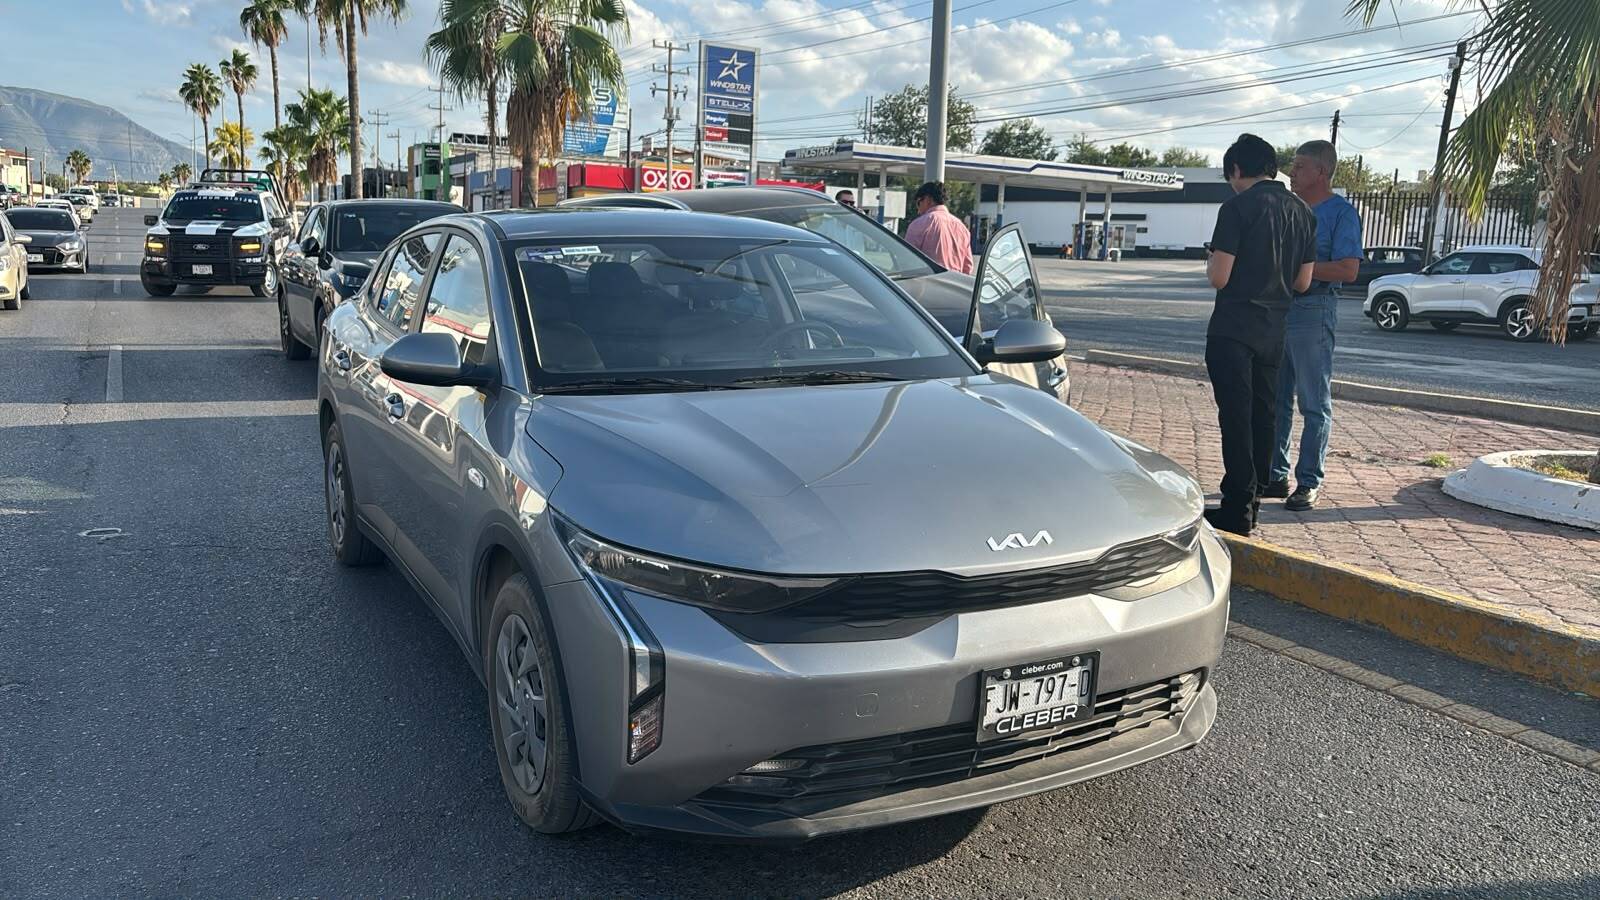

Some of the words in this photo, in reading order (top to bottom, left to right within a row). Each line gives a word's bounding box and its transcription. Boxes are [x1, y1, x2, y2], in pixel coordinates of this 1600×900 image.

[710, 80, 751, 91] WINDSTAR
[709, 98, 750, 109] STELL-X
[643, 170, 691, 189] OXXO
[1123, 169, 1170, 184] WINDSTAR
[1021, 661, 1064, 675] cleber.com
[996, 704, 1078, 734] CLEBER
